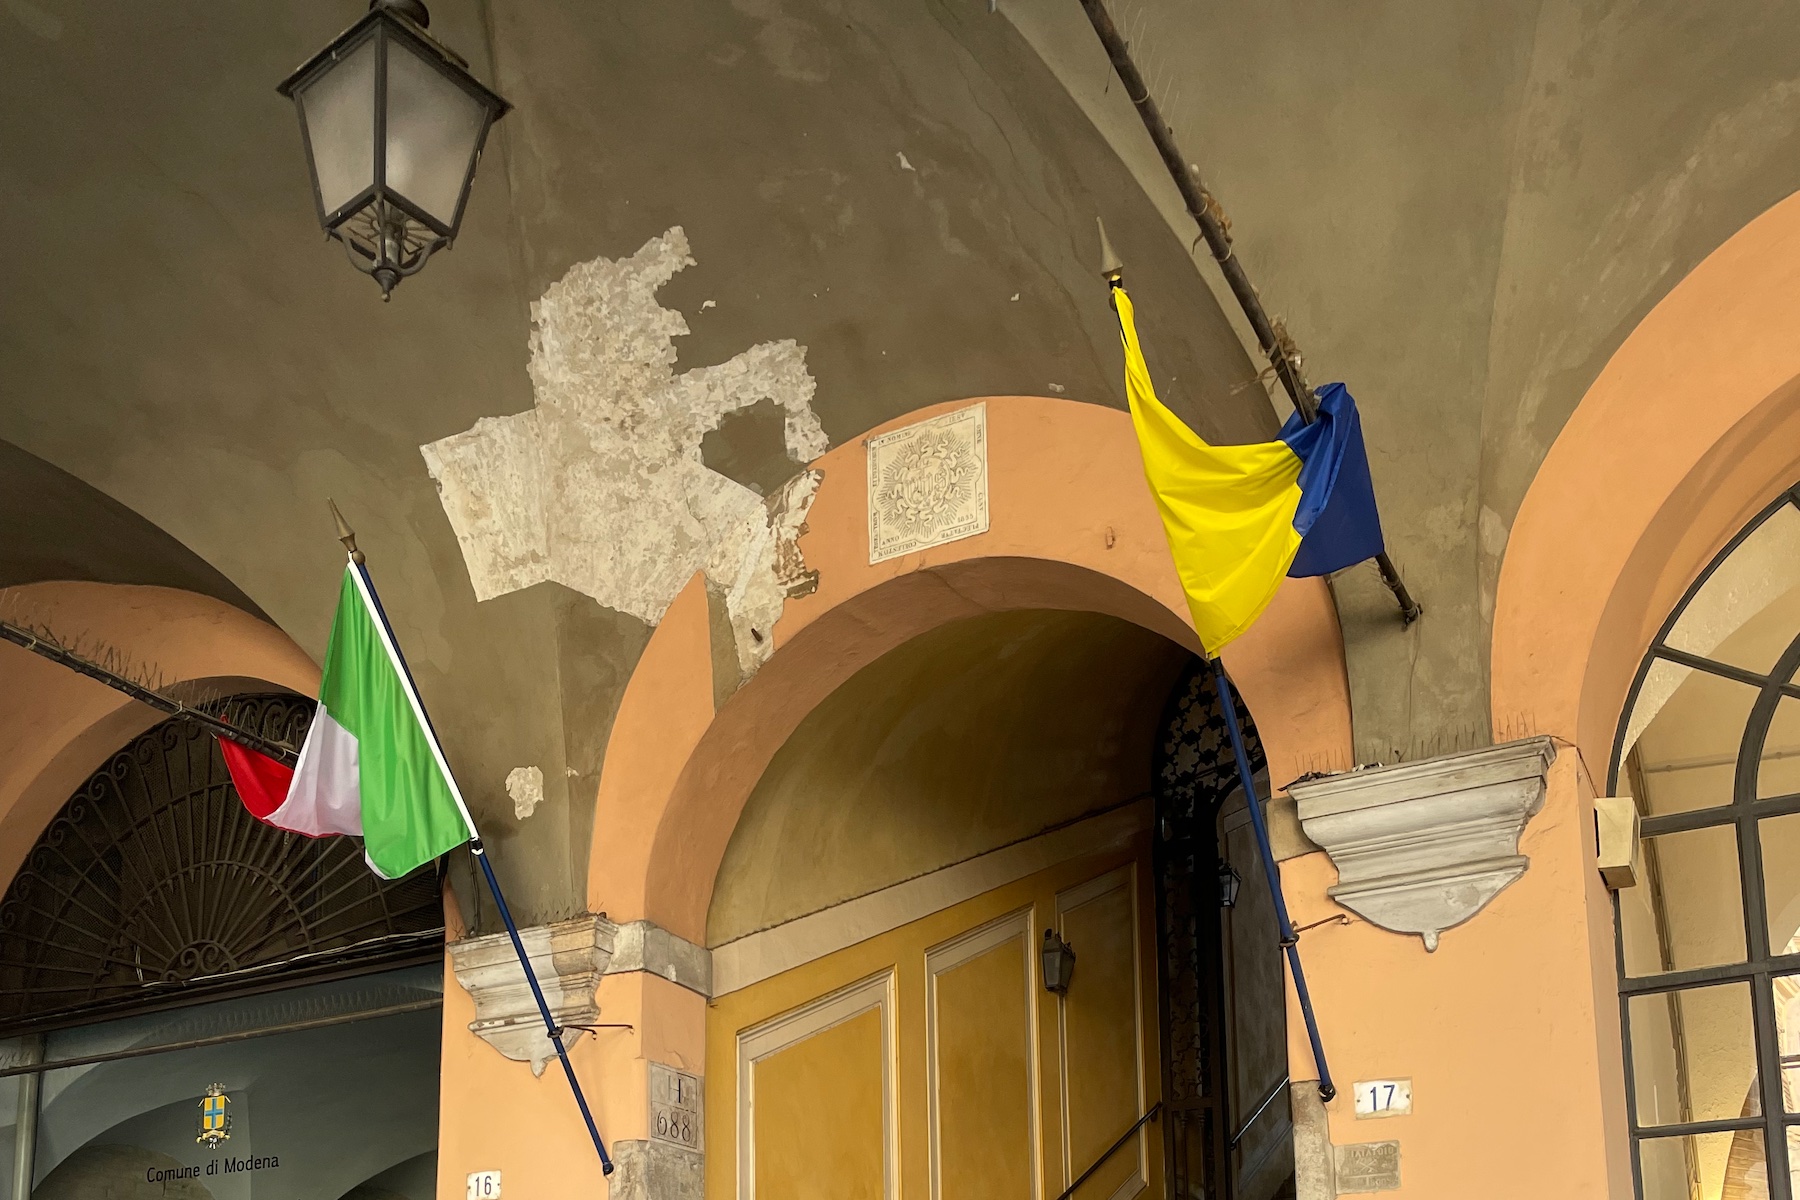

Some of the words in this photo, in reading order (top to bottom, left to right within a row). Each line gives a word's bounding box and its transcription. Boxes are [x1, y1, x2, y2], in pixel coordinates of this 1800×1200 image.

[668, 1075, 682, 1104] H
[1370, 1085, 1395, 1111] 17
[657, 1110, 691, 1142] 688
[147, 1166, 200, 1183] Comune
[206, 1160, 219, 1176] di
[224, 1155, 279, 1174] Modena
[475, 1175, 492, 1197] 16
